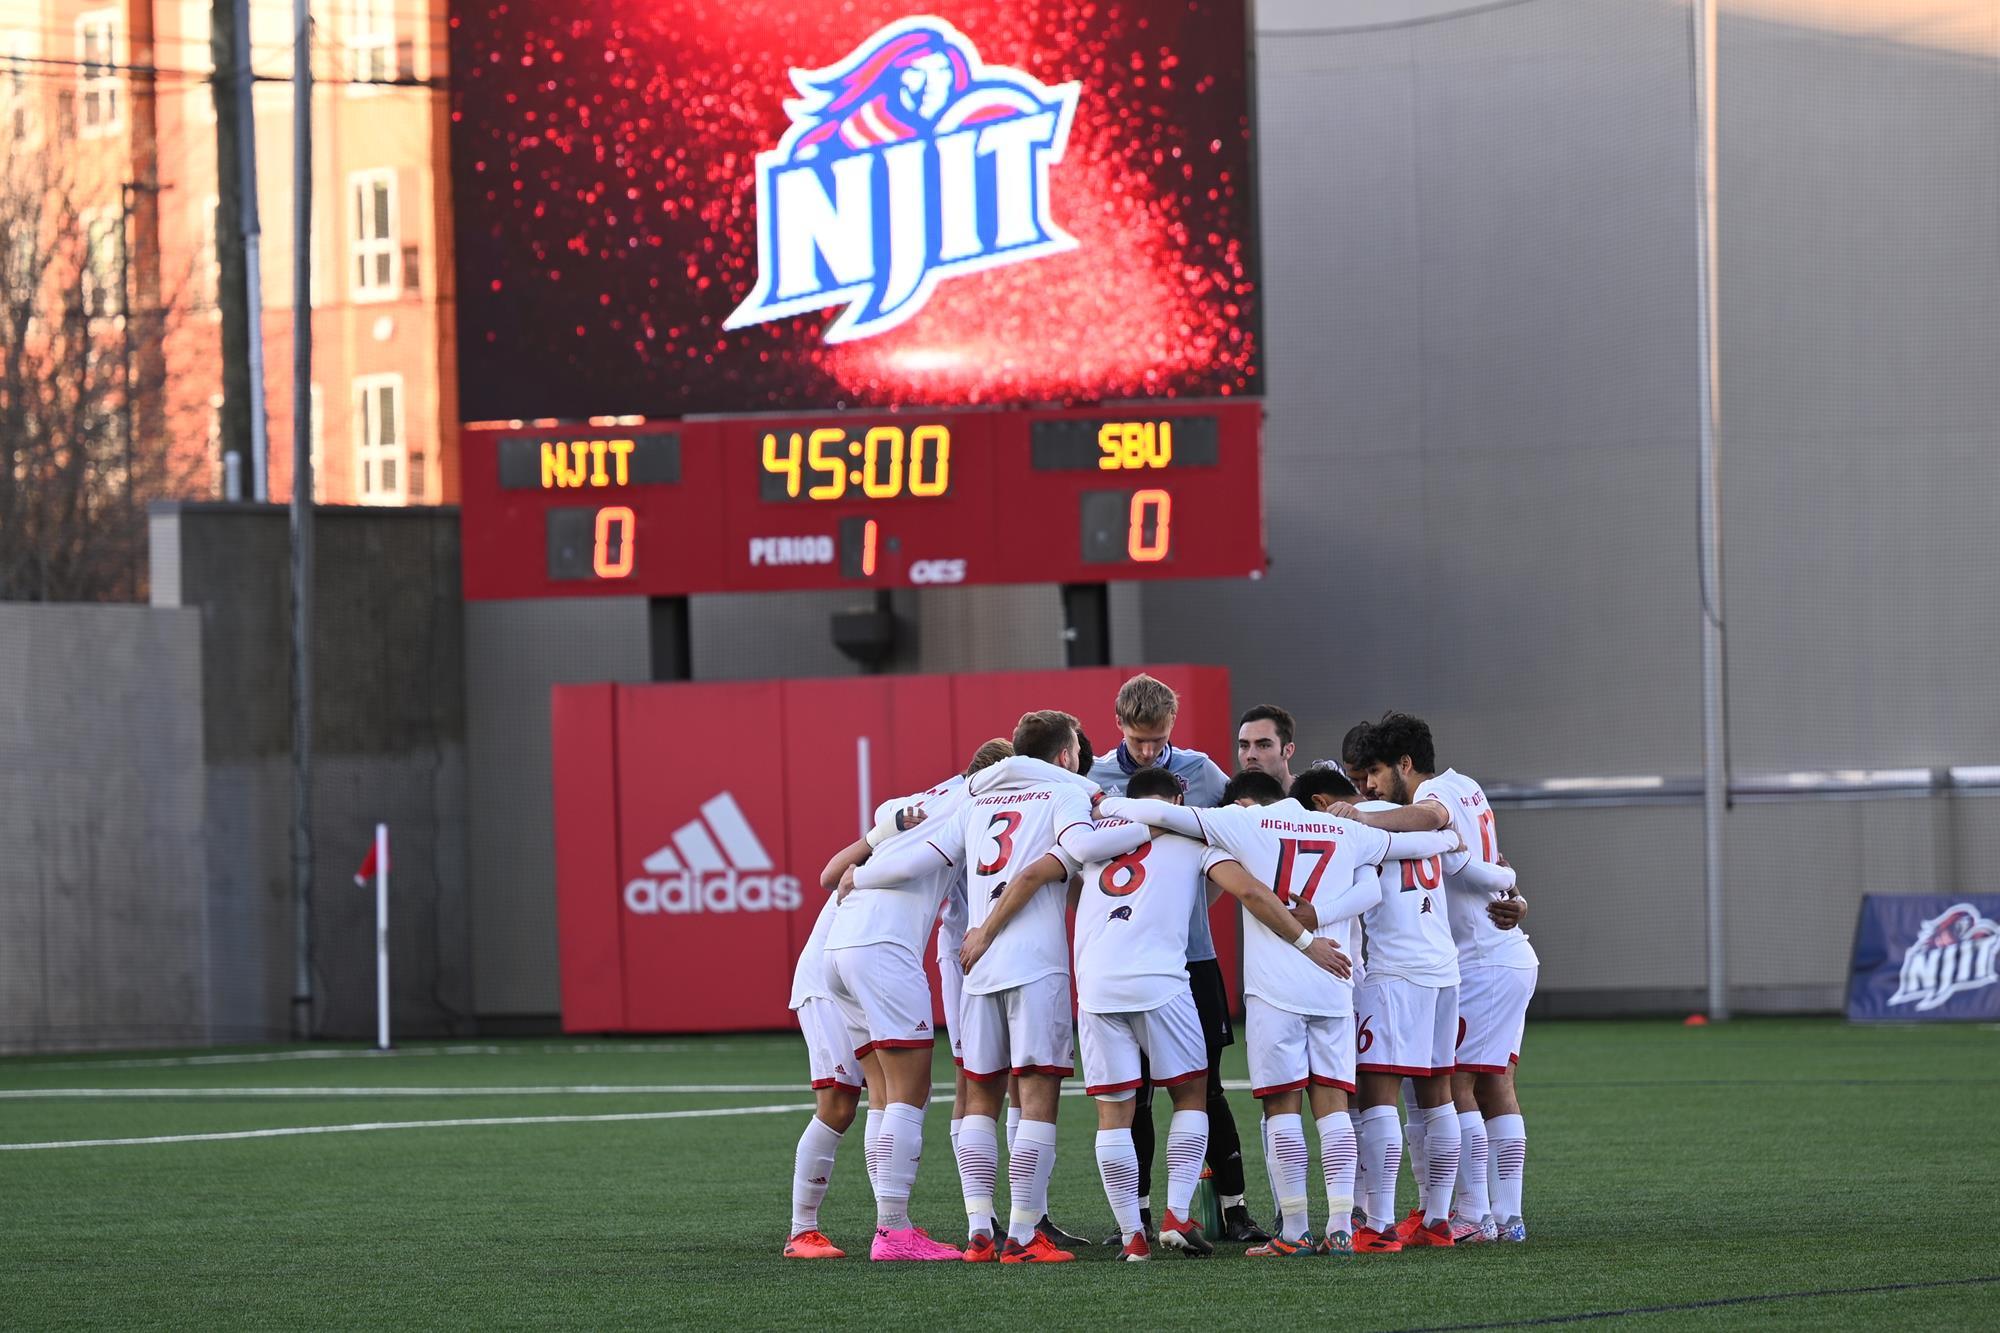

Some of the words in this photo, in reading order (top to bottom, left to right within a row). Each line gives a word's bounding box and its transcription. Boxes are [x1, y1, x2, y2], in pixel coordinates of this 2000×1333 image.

[738, 95, 1076, 337] NJIT
[541, 440, 634, 488] NJIT
[762, 425, 950, 499] 45:00
[1098, 422, 1172, 470] SBU
[594, 506, 635, 578] 0
[749, 535, 834, 566] PERIOD
[862, 519, 878, 577] 1
[1128, 490, 1171, 561] 0
[908, 558, 967, 584] OES
[975, 790, 1052, 807] HIGHLANDERS
[1260, 818, 1344, 835] HIGHLANDERS
[976, 811, 1022, 876] 3
[1099, 841, 1152, 896] 8
[624, 866, 802, 914] adidas
[1273, 838, 1337, 906] 17
[1889, 931, 2000, 1011] NJIT
